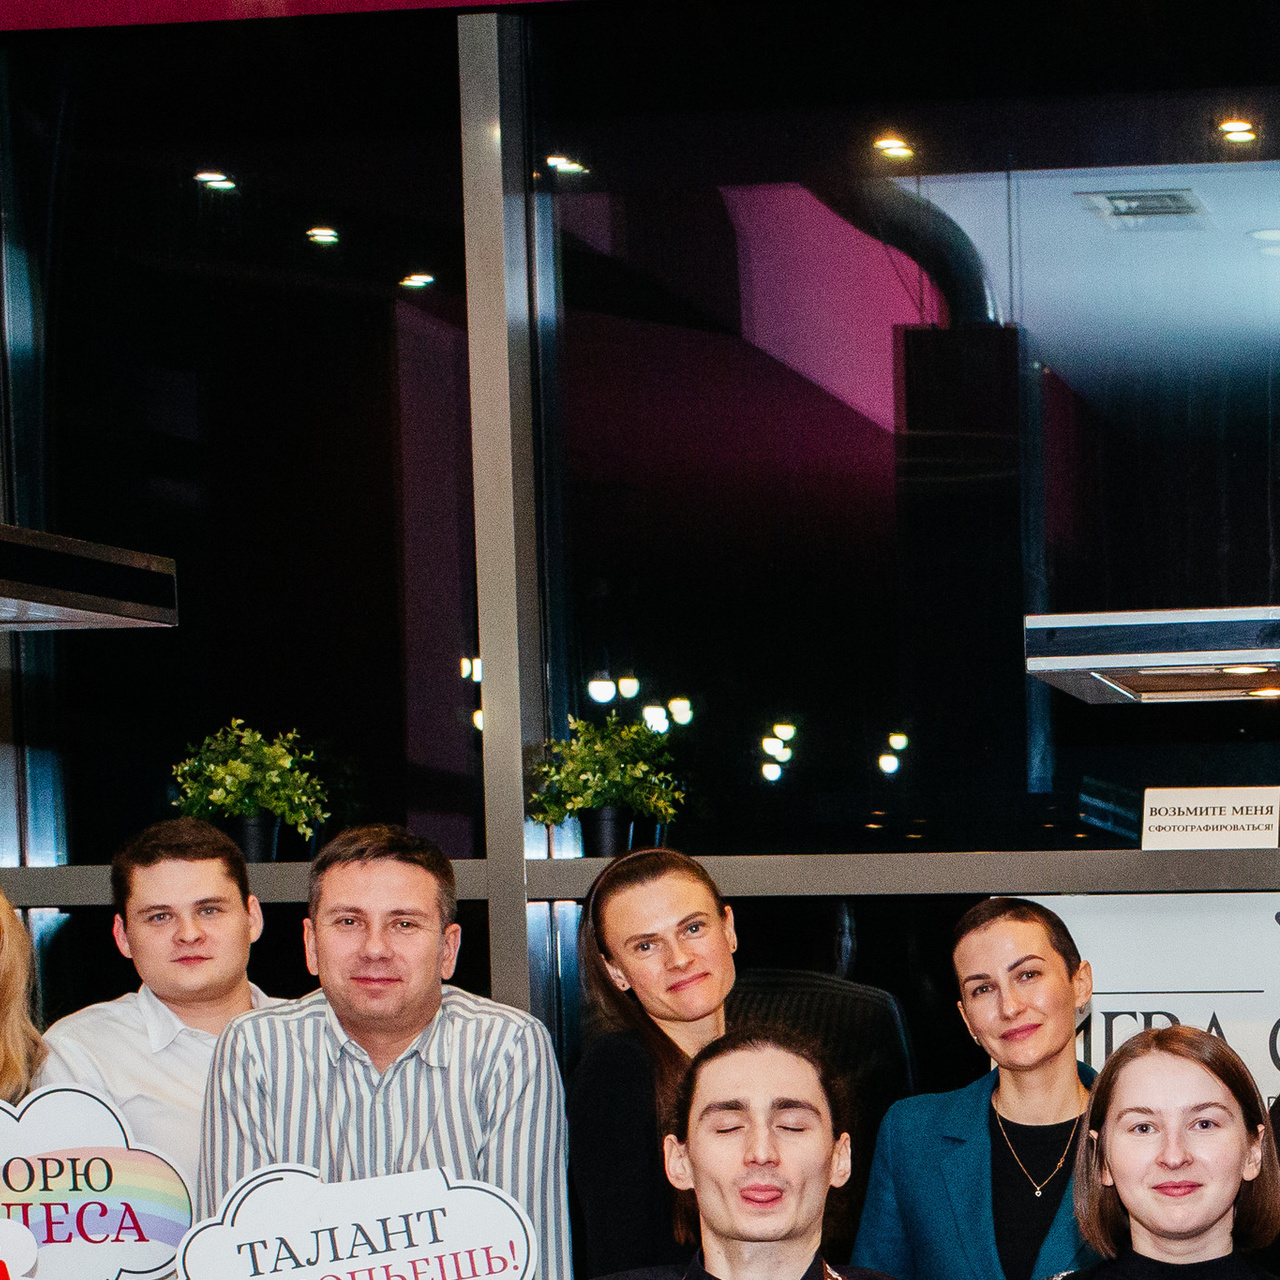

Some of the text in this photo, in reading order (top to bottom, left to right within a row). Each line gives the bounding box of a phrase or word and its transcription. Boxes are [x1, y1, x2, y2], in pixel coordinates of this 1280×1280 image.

[1149, 805, 1275, 817] ВОЗЬМИТЕ МЕНЯ
[1148, 823, 1274, 833] СФОТОГРАФИРОВАТЬСЯ!
[2, 1156, 114, 1193] ОРЮ
[236, 1207, 447, 1277] ТАЛАНТ
